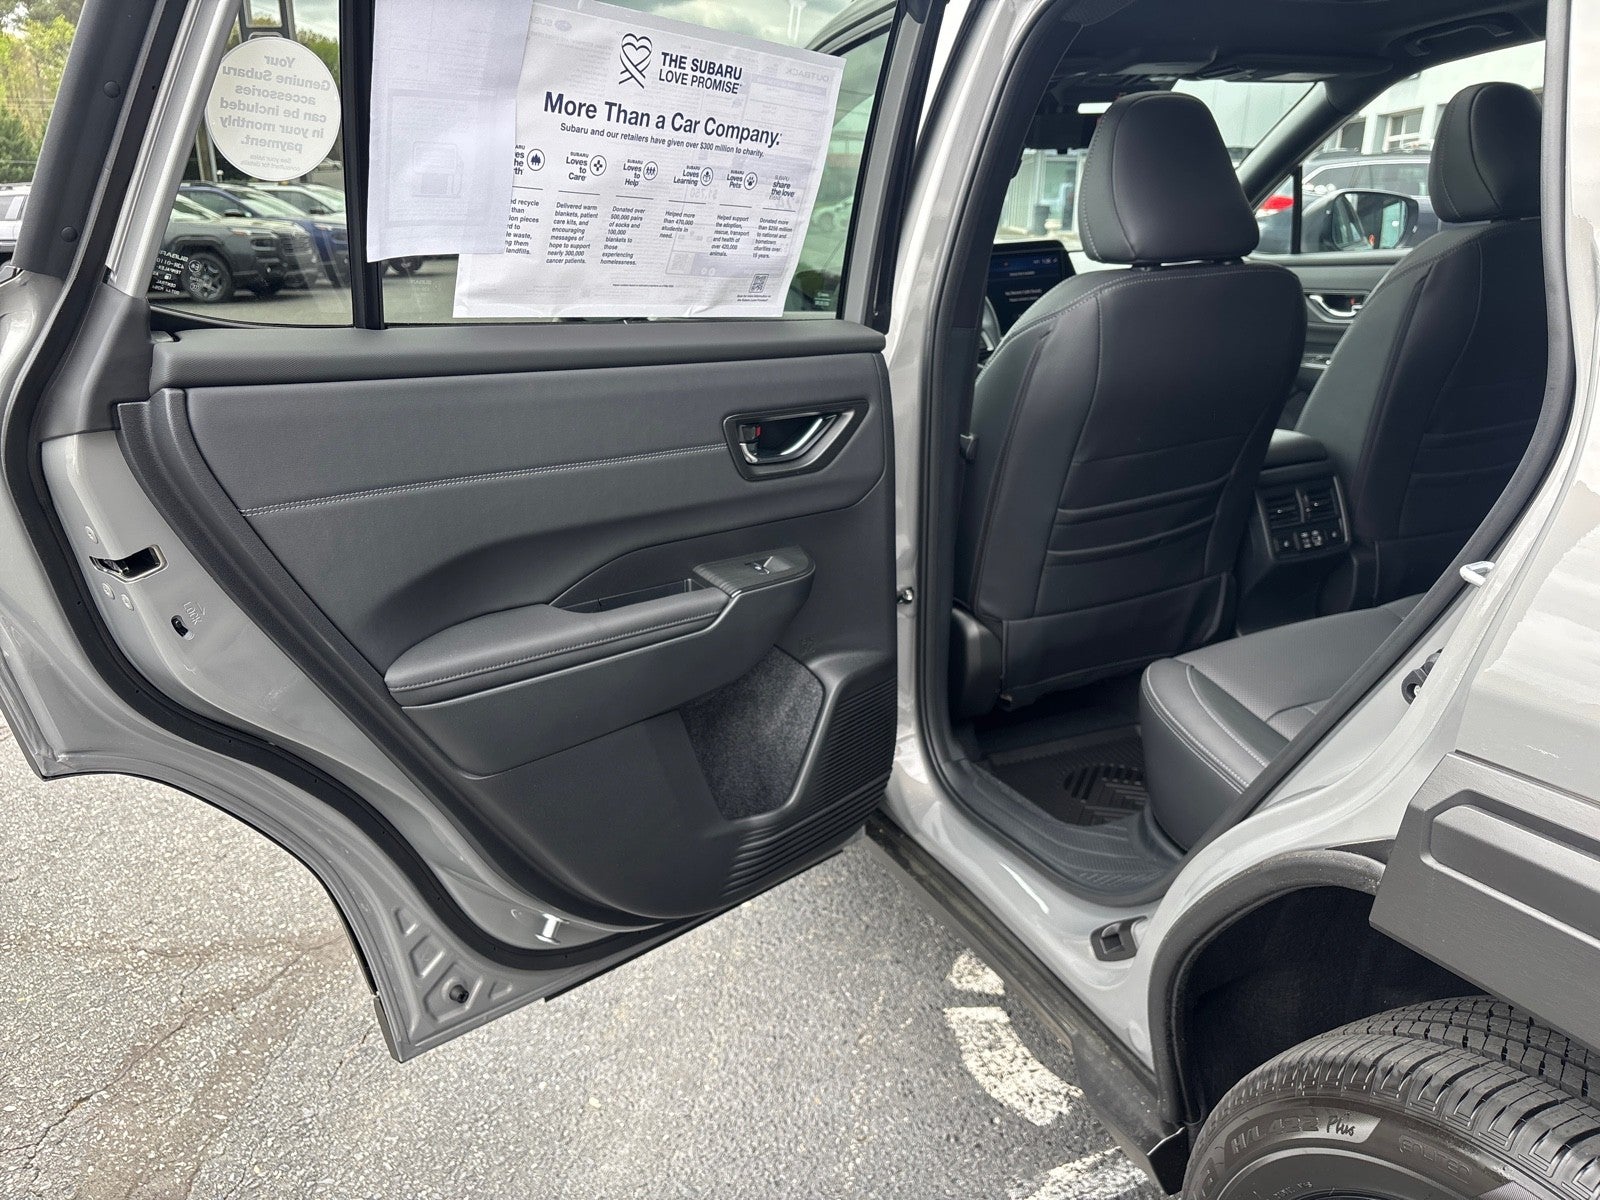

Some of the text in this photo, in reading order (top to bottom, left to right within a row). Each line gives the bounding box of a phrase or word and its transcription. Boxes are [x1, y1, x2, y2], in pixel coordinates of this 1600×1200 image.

[662, 52, 742, 80] THE SUBARU
[659, 69, 688, 85] LOVE
[544, 91, 597, 119] More
[605, 101, 650, 127] Than
[655, 115, 666, 129] a
[671, 112, 700, 133] Car
[560, 123, 588, 134] Subaru
[620, 133, 648, 143] retailers
[650, 136, 666, 144] have
[667, 139, 684, 147] given
[700, 142, 713, 150] $300
[714, 144, 734, 153] million
[743, 148, 764, 158] charity.
[566, 156, 587, 166] Loves
[569, 172, 586, 181] Care
[625, 178, 639, 187] Help
[673, 176, 698, 186] Learning
[183, 601, 202, 625] LOCK
[1326, 1114, 1356, 1137] Plus
